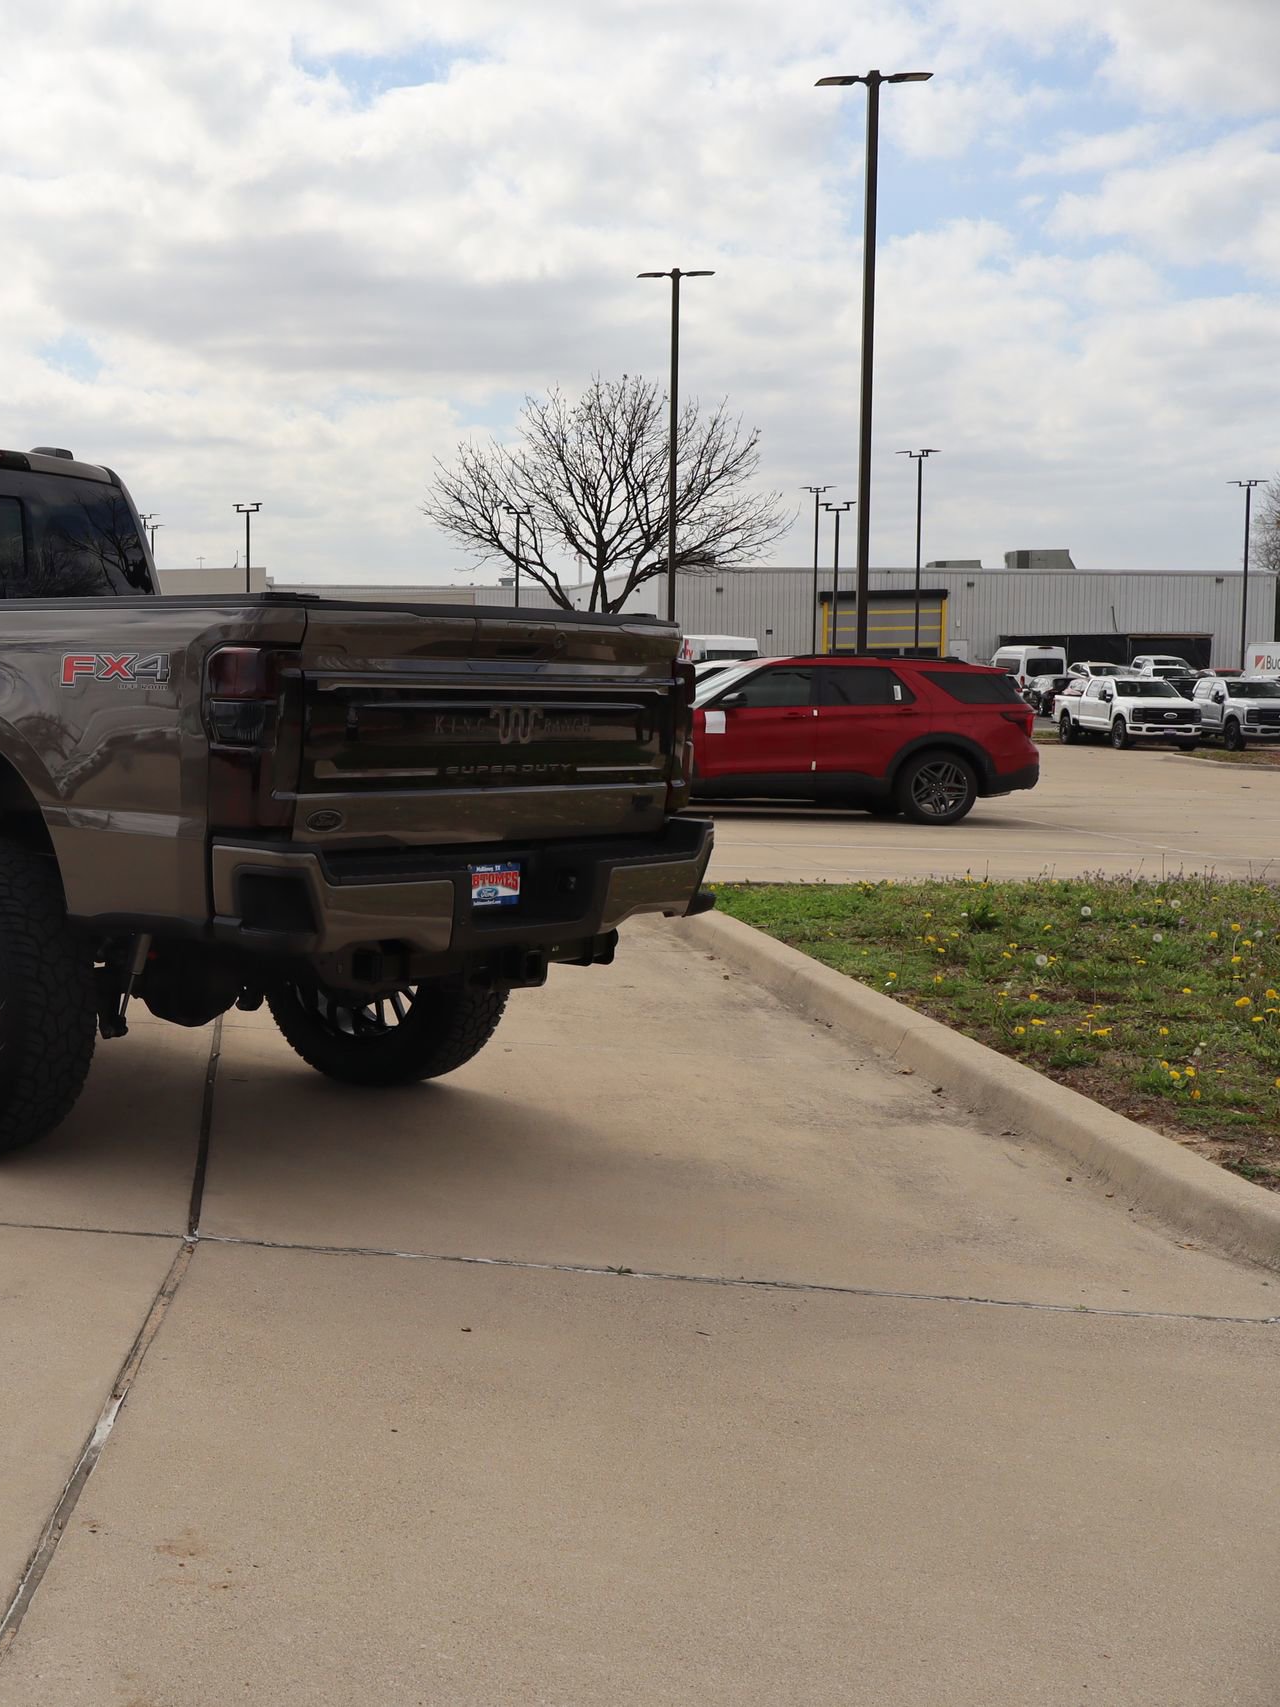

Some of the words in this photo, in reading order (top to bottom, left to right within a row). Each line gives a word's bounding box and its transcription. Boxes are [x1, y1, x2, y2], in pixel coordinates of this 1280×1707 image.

[60, 652, 170, 688] FX4
[446, 765, 518, 775] SUPER
[521, 763, 573, 773] DUTY
[479, 888, 497, 898] Ford
